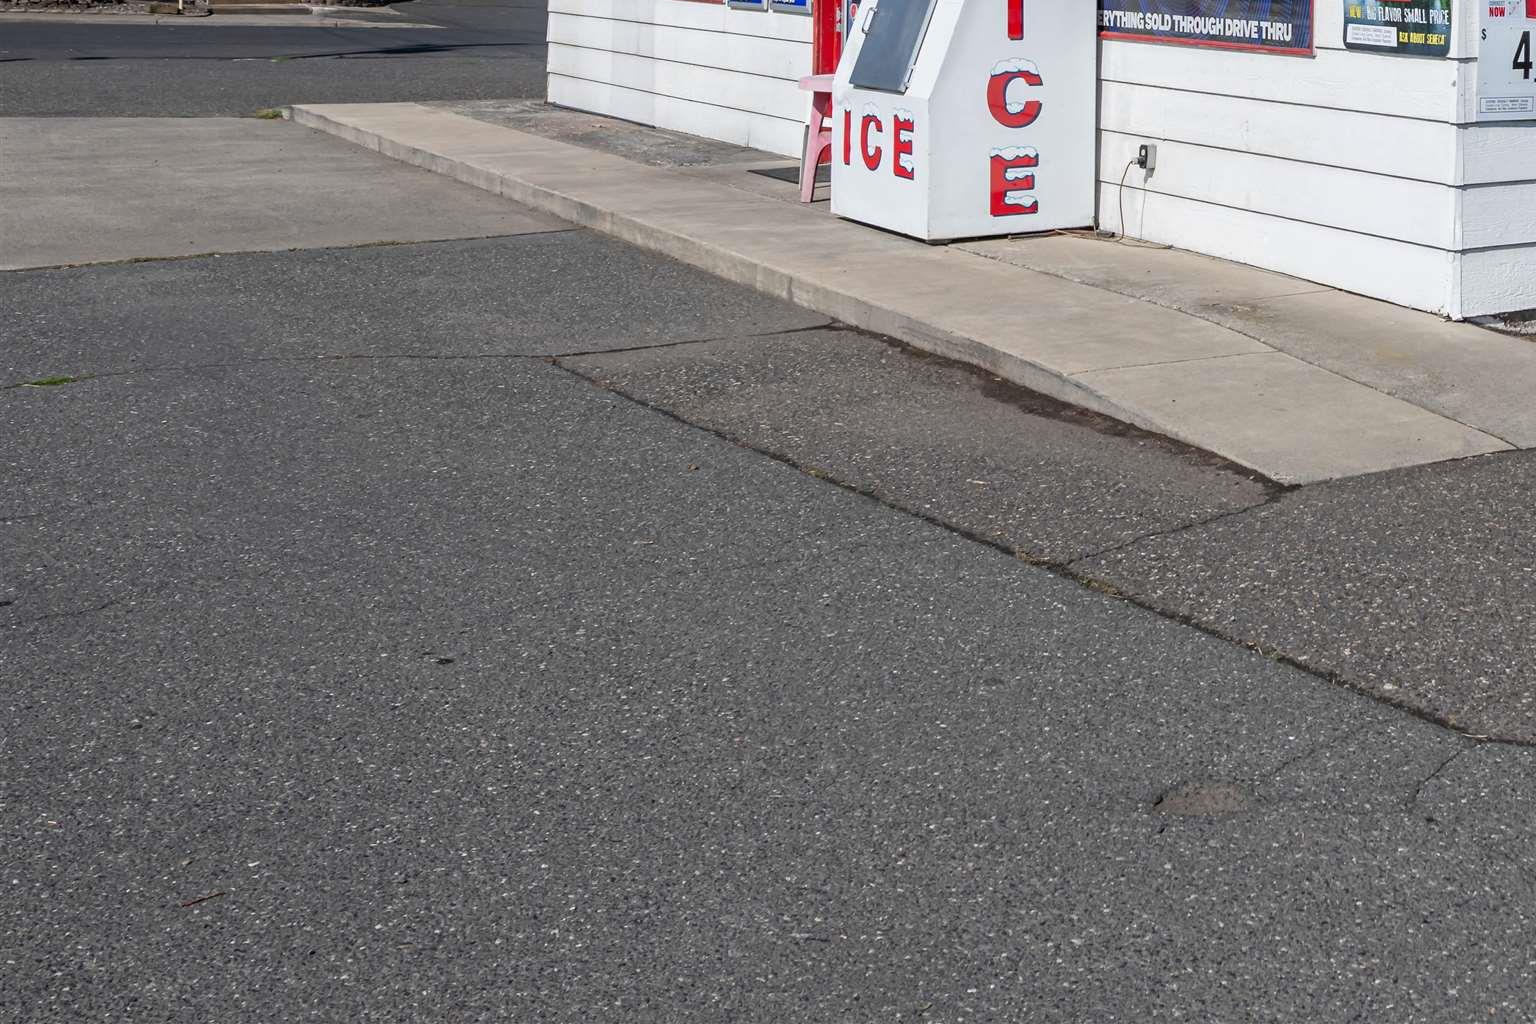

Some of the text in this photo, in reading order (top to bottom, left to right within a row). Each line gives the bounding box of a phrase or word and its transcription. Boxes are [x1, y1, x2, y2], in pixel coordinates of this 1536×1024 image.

[1378, 6, 1402, 22] FLAVOR
[1404, 8, 1427, 23] SMALL
[1429, 9, 1450, 24] PRICE
[1489, 6, 1506, 17] NOW
[1097, 10, 1292, 41] ERYTHING SOLD THROUGH DRIVE THRU
[1481, 28, 1487, 40] $
[843, 103, 915, 181] ICE
